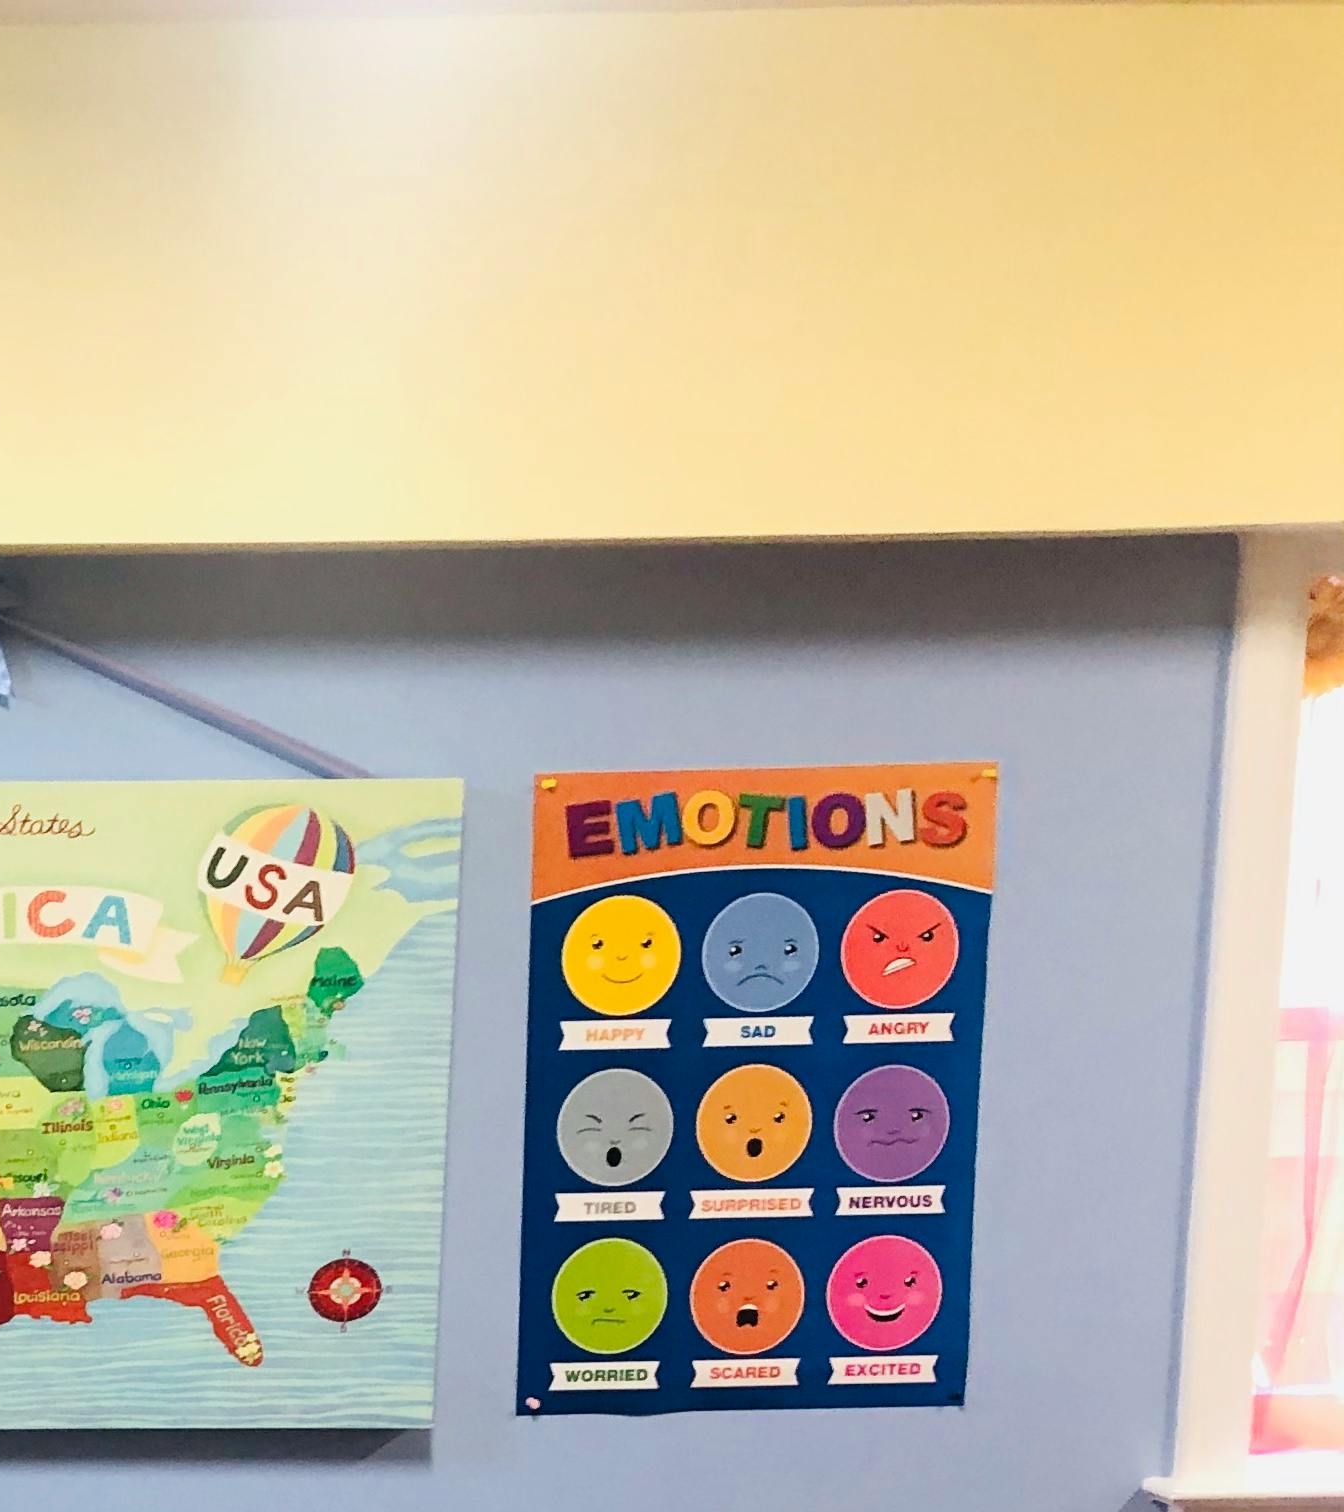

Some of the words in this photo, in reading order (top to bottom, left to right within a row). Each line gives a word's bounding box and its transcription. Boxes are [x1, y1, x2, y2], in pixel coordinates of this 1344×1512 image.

[565, 787, 968, 857] EMOTIONS
[206, 846, 324, 922] USA
[584, 1027, 645, 1044] HAPPY
[741, 1024, 776, 1039] SAD
[868, 1021, 929, 1037] ANGRY
[19, 1037, 83, 1051] Wisconsin
[232, 1052, 264, 1064] York
[141, 1099, 170, 1109] Ohio
[42, 1119, 93, 1135] Illinois
[207, 1154, 255, 1169] Virginia
[2, 1204, 61, 1217] Arkansas
[583, 1200, 636, 1215] TIRED
[701, 1197, 801, 1213] SURPRISED
[848, 1194, 932, 1211] NERVOUS
[102, 1272, 162, 1284] Alabama
[14, 1290, 81, 1304] Louisiana
[565, 1367, 648, 1384] WORRIED
[710, 1364, 781, 1380] SCARED
[844, 1362, 921, 1378] EXCITED
